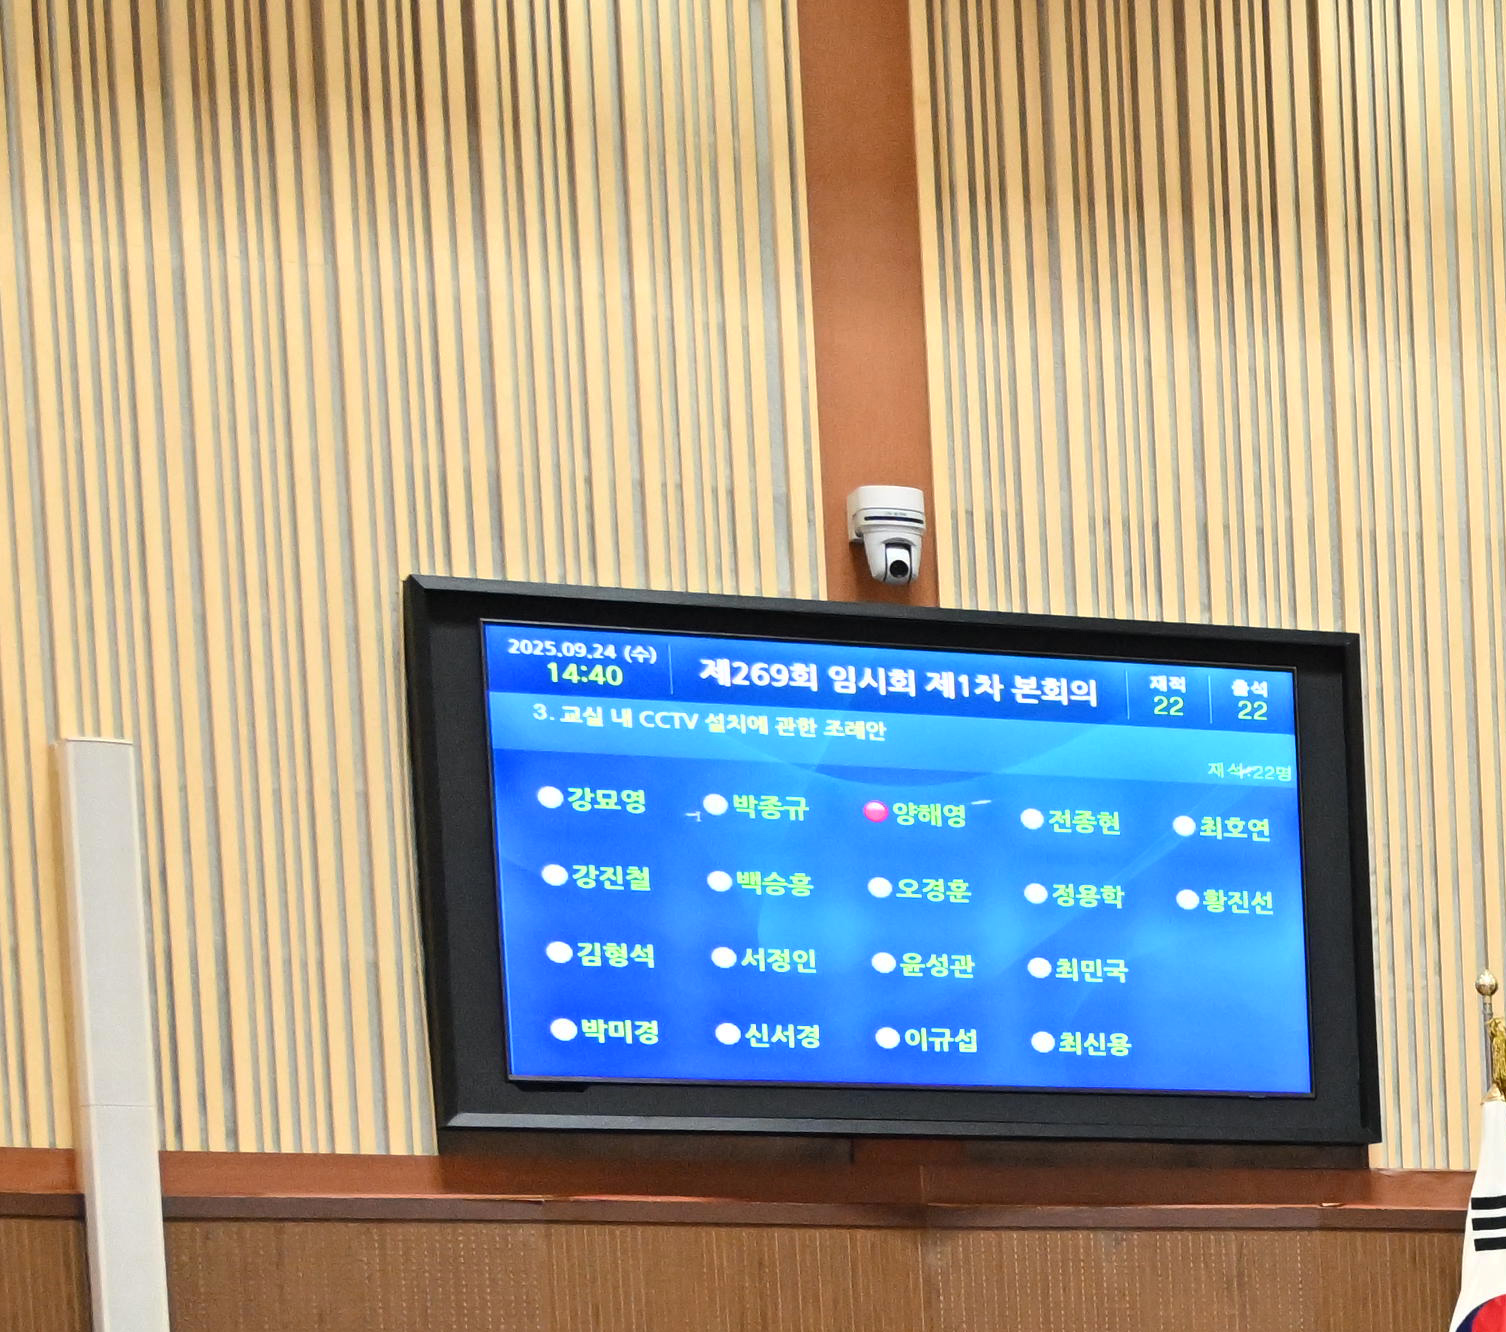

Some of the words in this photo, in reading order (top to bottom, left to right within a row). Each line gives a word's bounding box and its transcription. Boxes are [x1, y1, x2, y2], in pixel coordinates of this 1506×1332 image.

[507, 638, 618, 661] 2025.09.24
[623, 644, 659, 665] (수)
[546, 661, 624, 687] 14:40
[699, 656, 820, 692] 제269회
[827, 664, 918, 698] 임시회
[924, 670, 1006, 703] 제1차
[1011, 675, 1099, 708] 본회의
[1148, 674, 1188, 695] 재적
[1230, 678, 1270, 698] 출석
[1153, 695, 1185, 716] 22
[1237, 699, 1269, 721] 22
[532, 702, 556, 723] 3.
[559, 703, 604, 729] 교실
[610, 707, 633, 729] 내
[637, 710, 700, 732] CCTV
[705, 711, 770, 736] 설치에
[775, 715, 818, 739] 관한
[567, 787, 648, 814] 강묘영
[732, 793, 811, 821] 박종규
[892, 801, 967, 829] 양해영
[1198, 815, 1271, 843] 최호연
[571, 864, 652, 892] 강진철
[895, 876, 972, 904] 오경훈
[1051, 882, 1126, 909] 정용학
[576, 941, 656, 969] 김형석
[741, 947, 817, 974] 서정인
[899, 952, 976, 980] 윤성관
[1054, 956, 1130, 984] 최민국
[580, 1018, 660, 1045] 박미경
[744, 1023, 821, 1049] 신서경
[904, 1026, 979, 1054] 이규섭
[1058, 1030, 1133, 1058] 최신용
